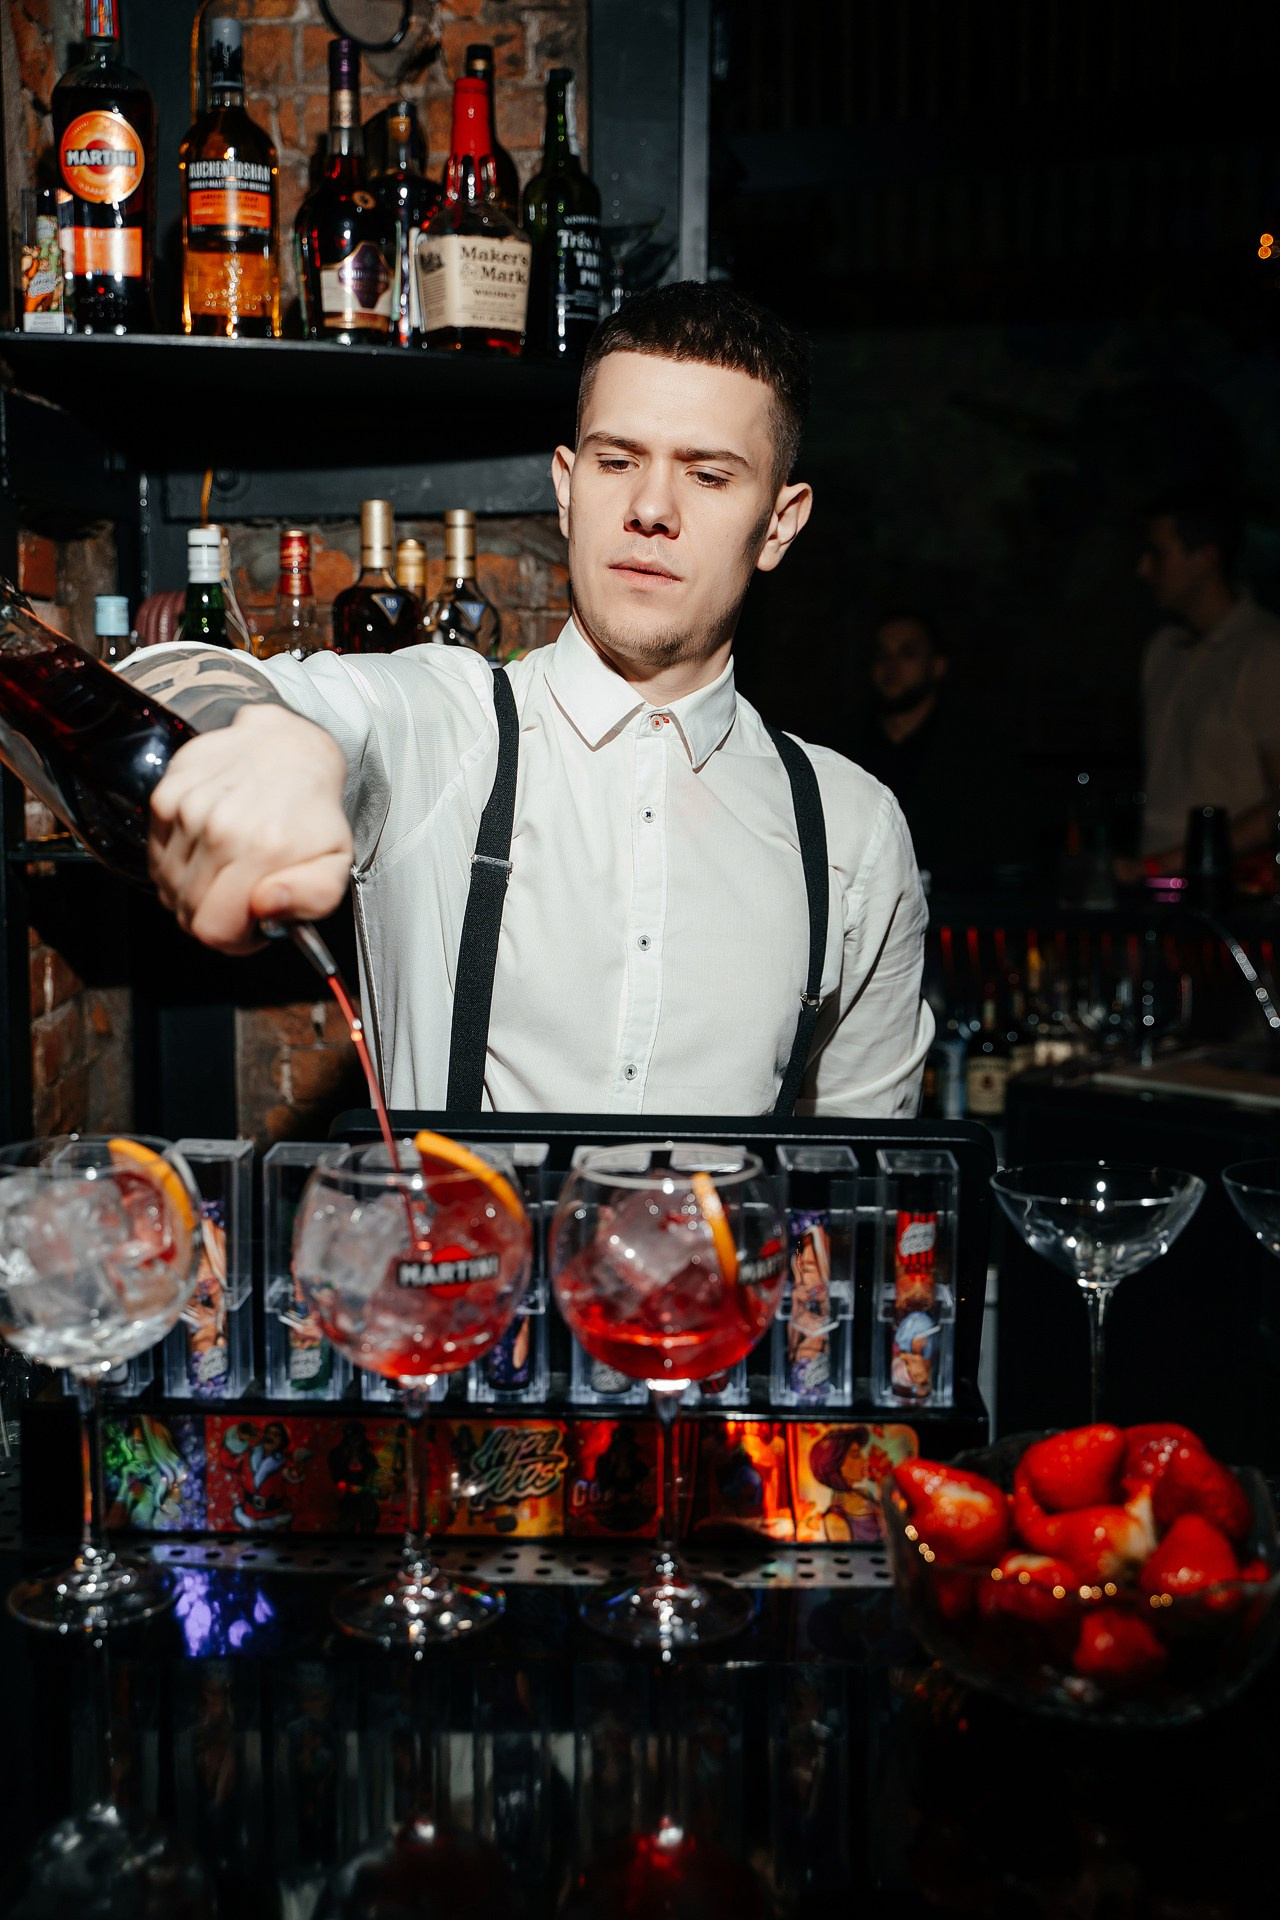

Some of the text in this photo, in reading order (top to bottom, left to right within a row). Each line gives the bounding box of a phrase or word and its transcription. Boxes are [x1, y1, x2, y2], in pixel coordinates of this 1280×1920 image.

[66, 149, 136, 167] MARTINI
[460, 245, 528, 266] Maker's
[482, 265, 527, 285] Mark
[399, 1254, 499, 1287] MARTINI
